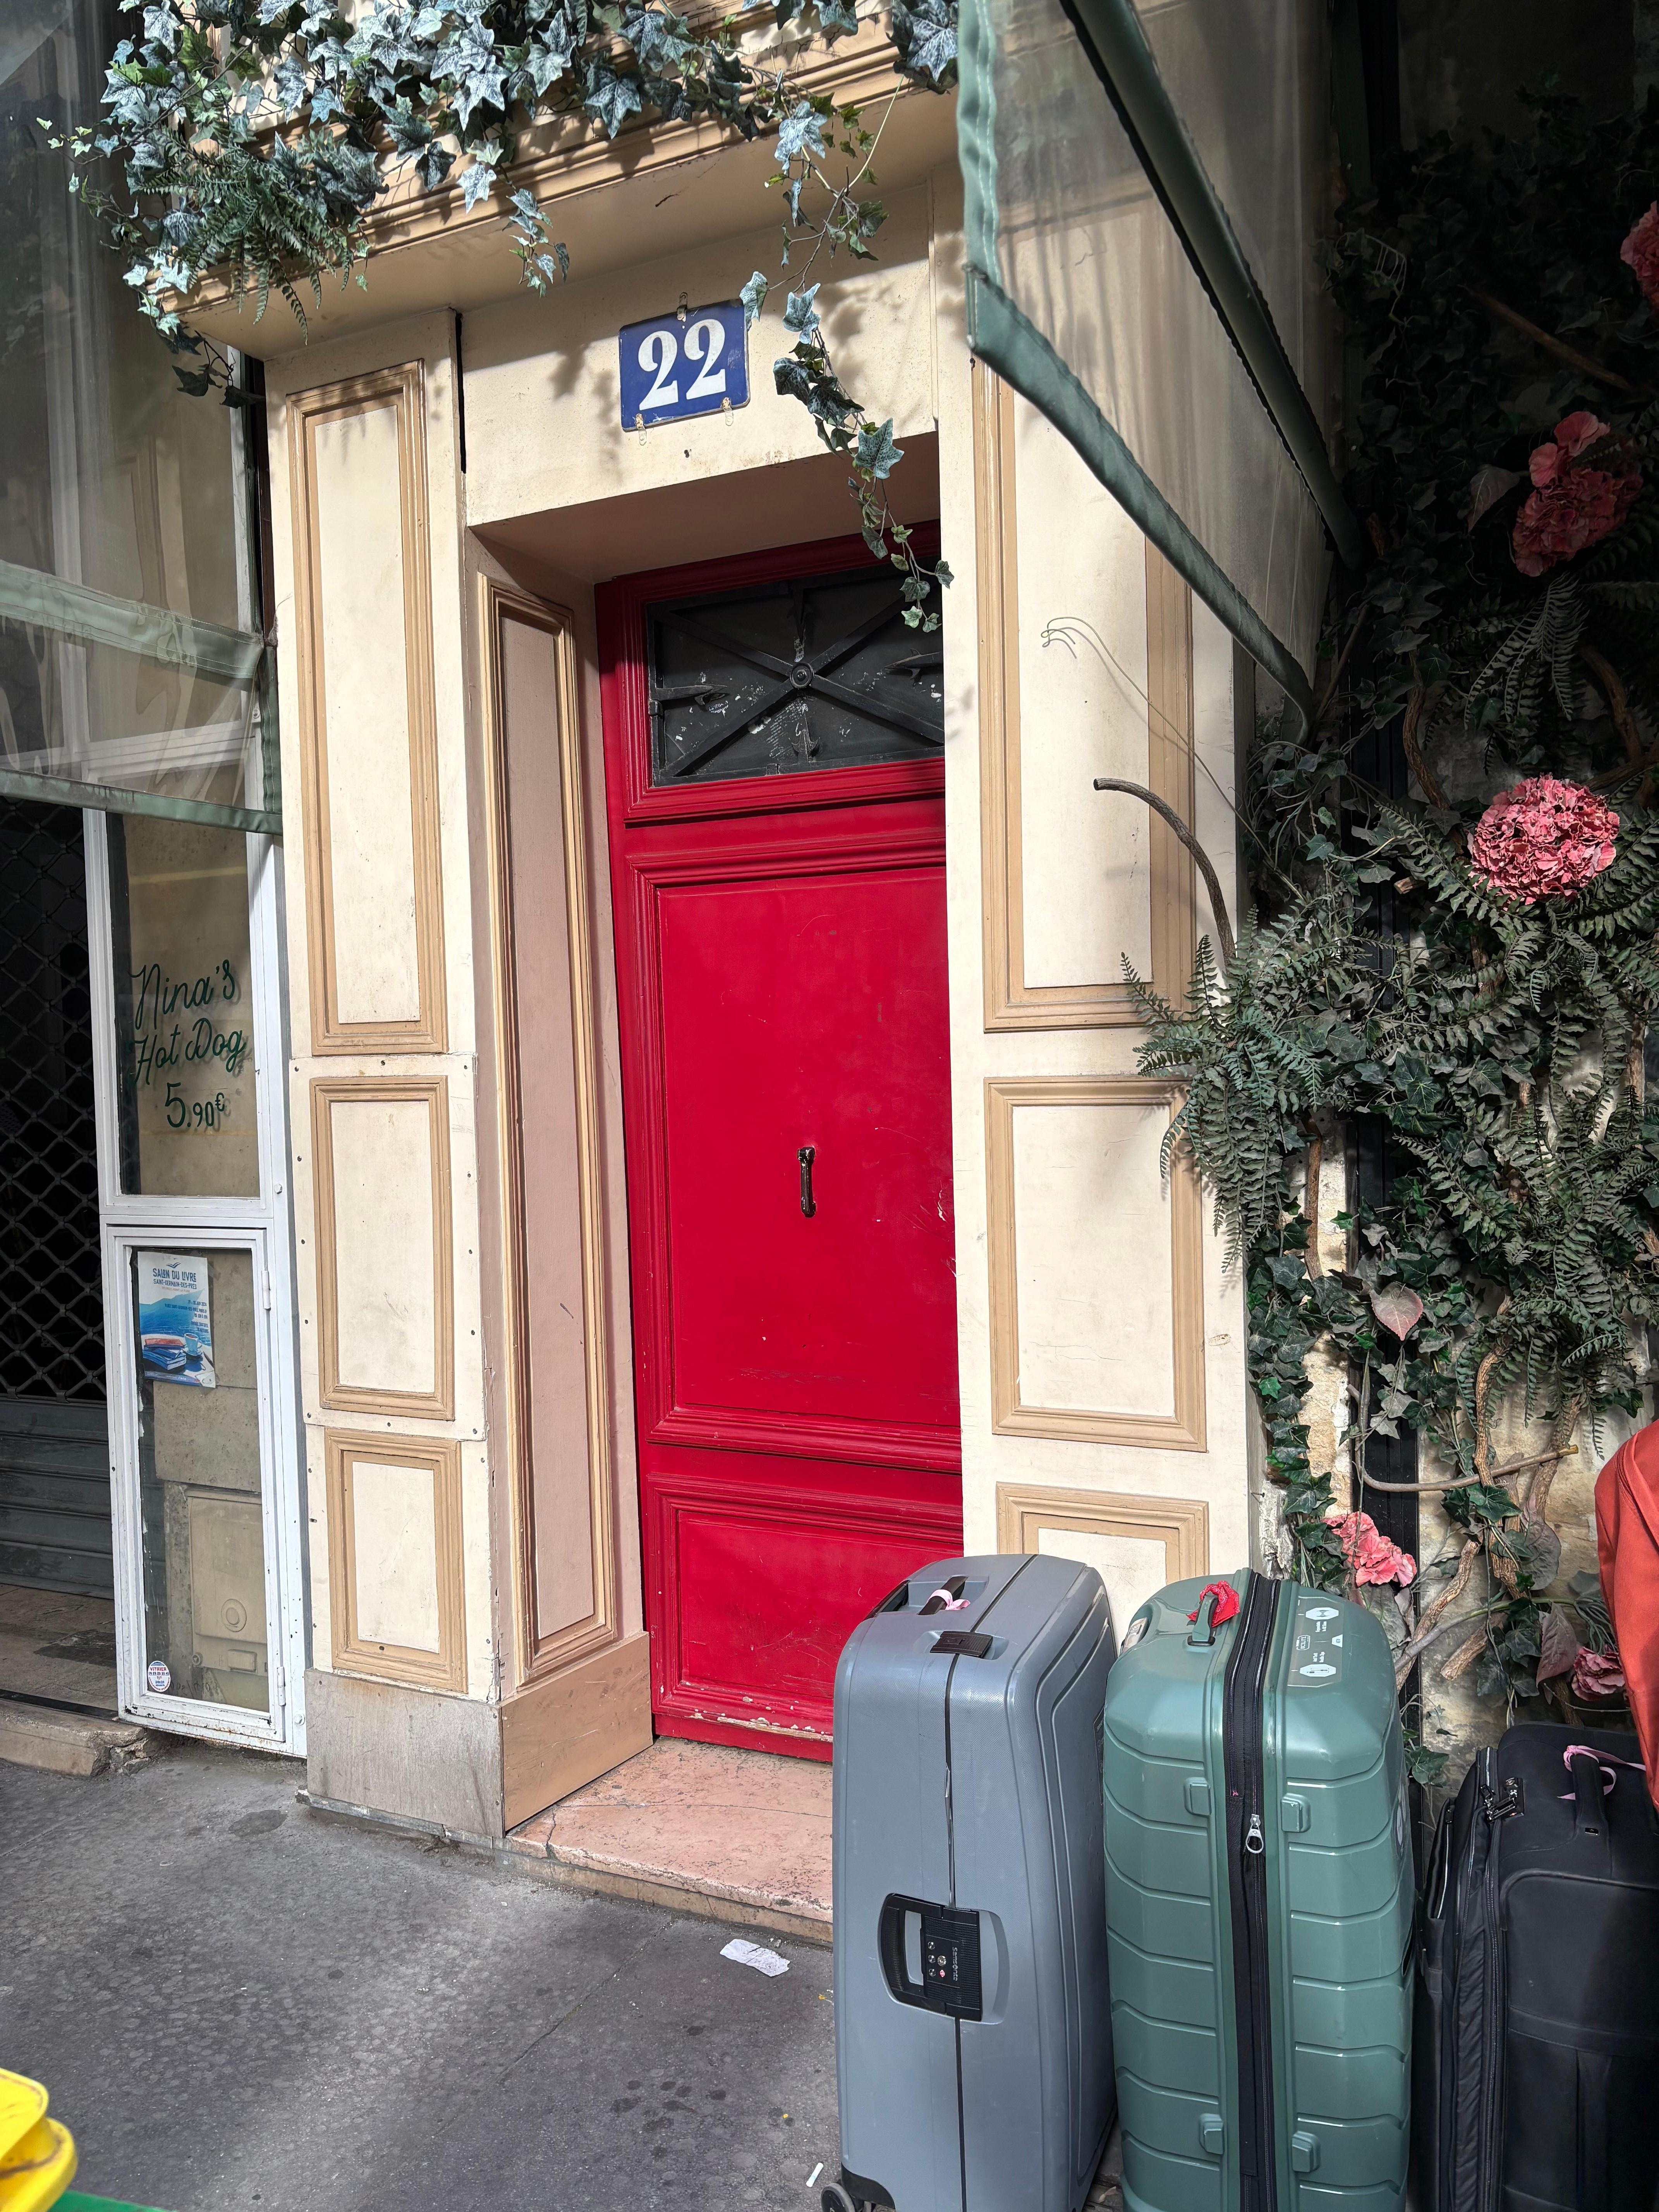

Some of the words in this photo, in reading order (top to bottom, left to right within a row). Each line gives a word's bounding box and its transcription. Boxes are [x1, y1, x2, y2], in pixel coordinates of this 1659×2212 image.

[638, 319, 726, 411] 22
[128, 959, 235, 1030] Nina's
[126, 1024, 181, 1085] Hot
[185, 1017, 247, 1073] Dog
[165, 1082, 225, 1128] 5.90€
[153, 1268, 170, 1279] SALON
[172, 1270, 180, 1280] DU
[182, 1271, 197, 1282] LIVRE
